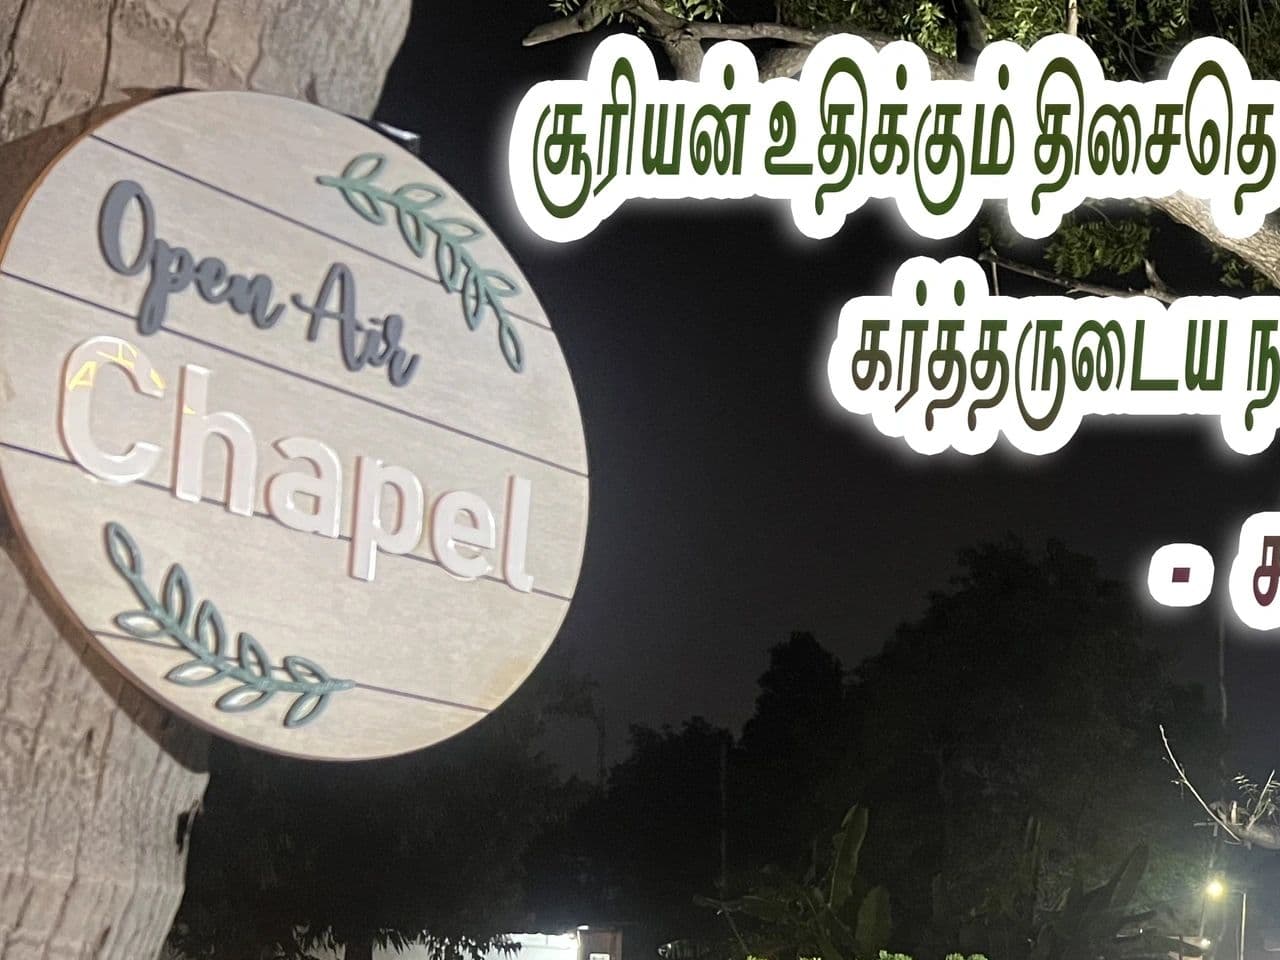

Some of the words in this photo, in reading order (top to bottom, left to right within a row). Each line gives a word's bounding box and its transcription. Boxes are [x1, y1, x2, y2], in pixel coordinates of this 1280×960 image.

[97, 179, 286, 336] Open
[291, 262, 420, 387] Air
[57, 335, 535, 593] Chapel
